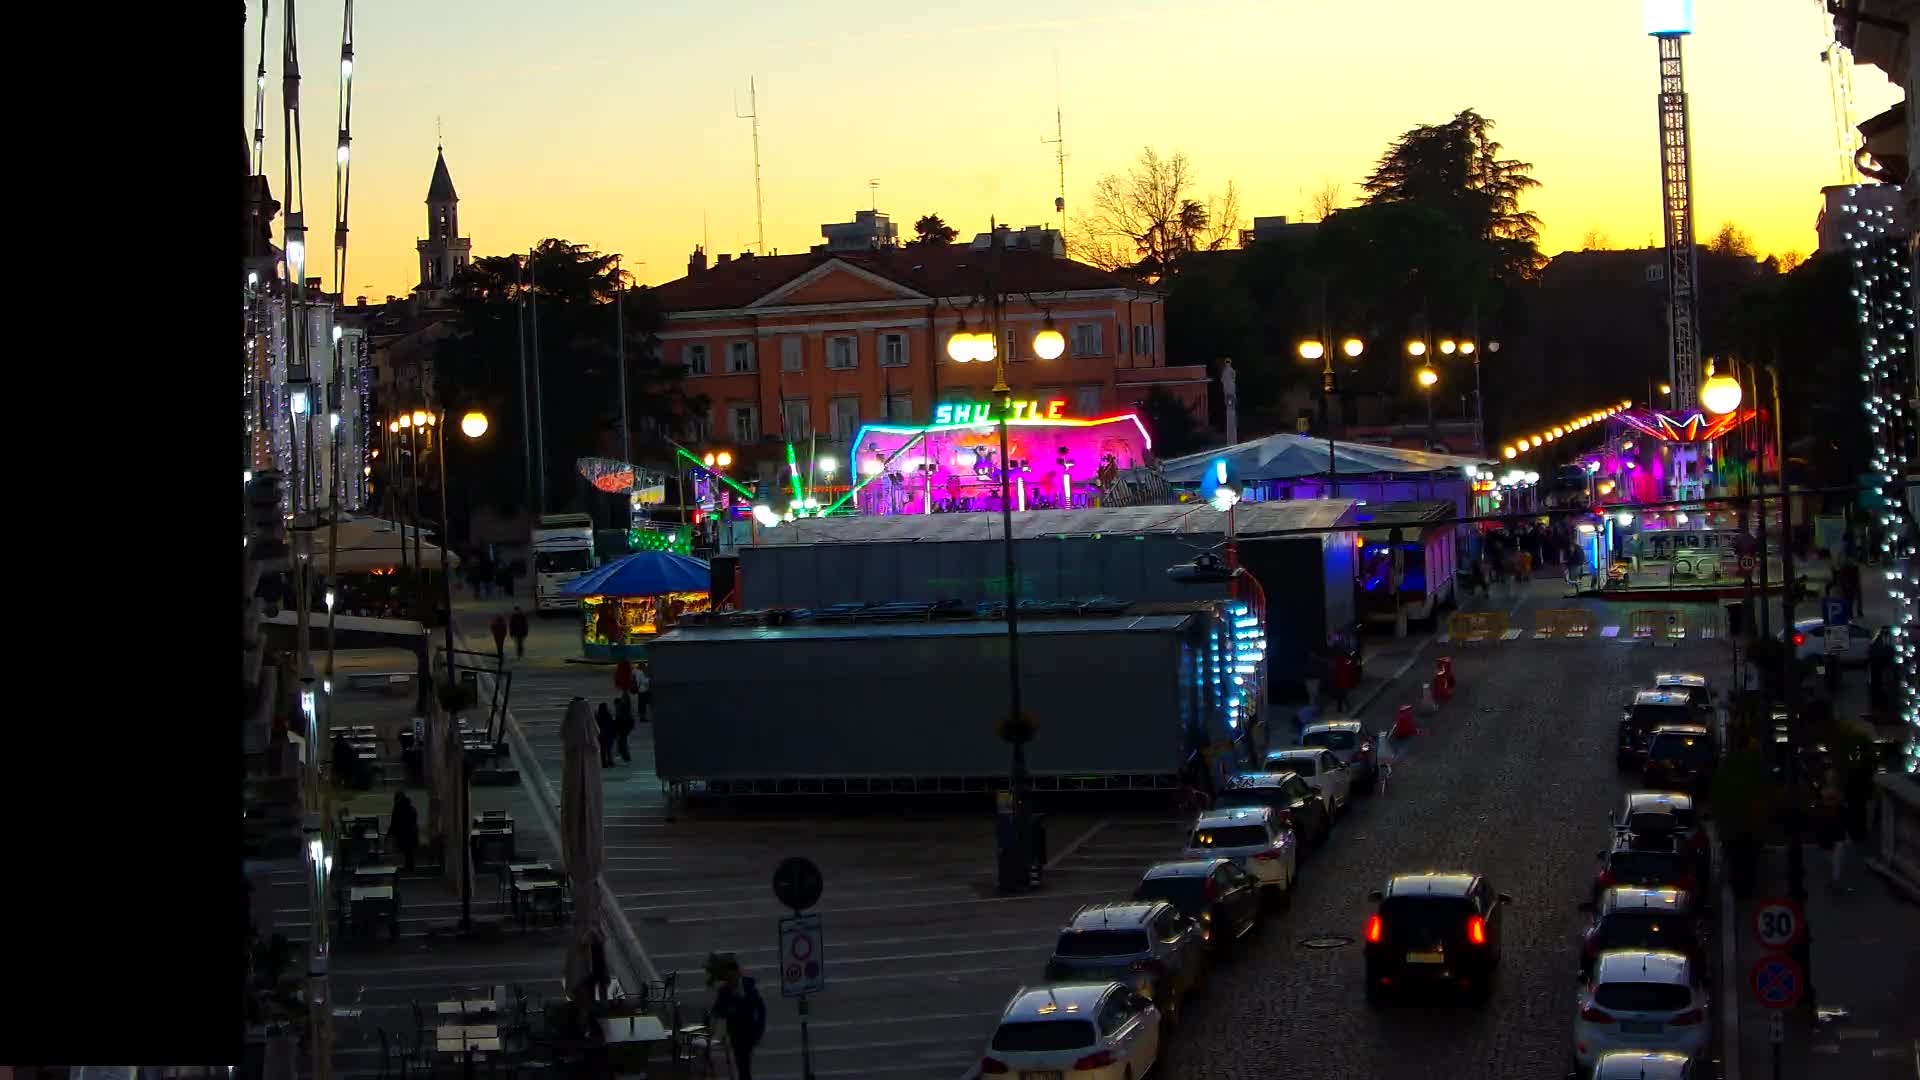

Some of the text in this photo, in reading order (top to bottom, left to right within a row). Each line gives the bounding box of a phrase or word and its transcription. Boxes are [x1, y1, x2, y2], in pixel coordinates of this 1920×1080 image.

[935, 399, 1065, 424] SHUTLE
[1827, 602, 1842, 624] P
[1762, 911, 1791, 938] 30
